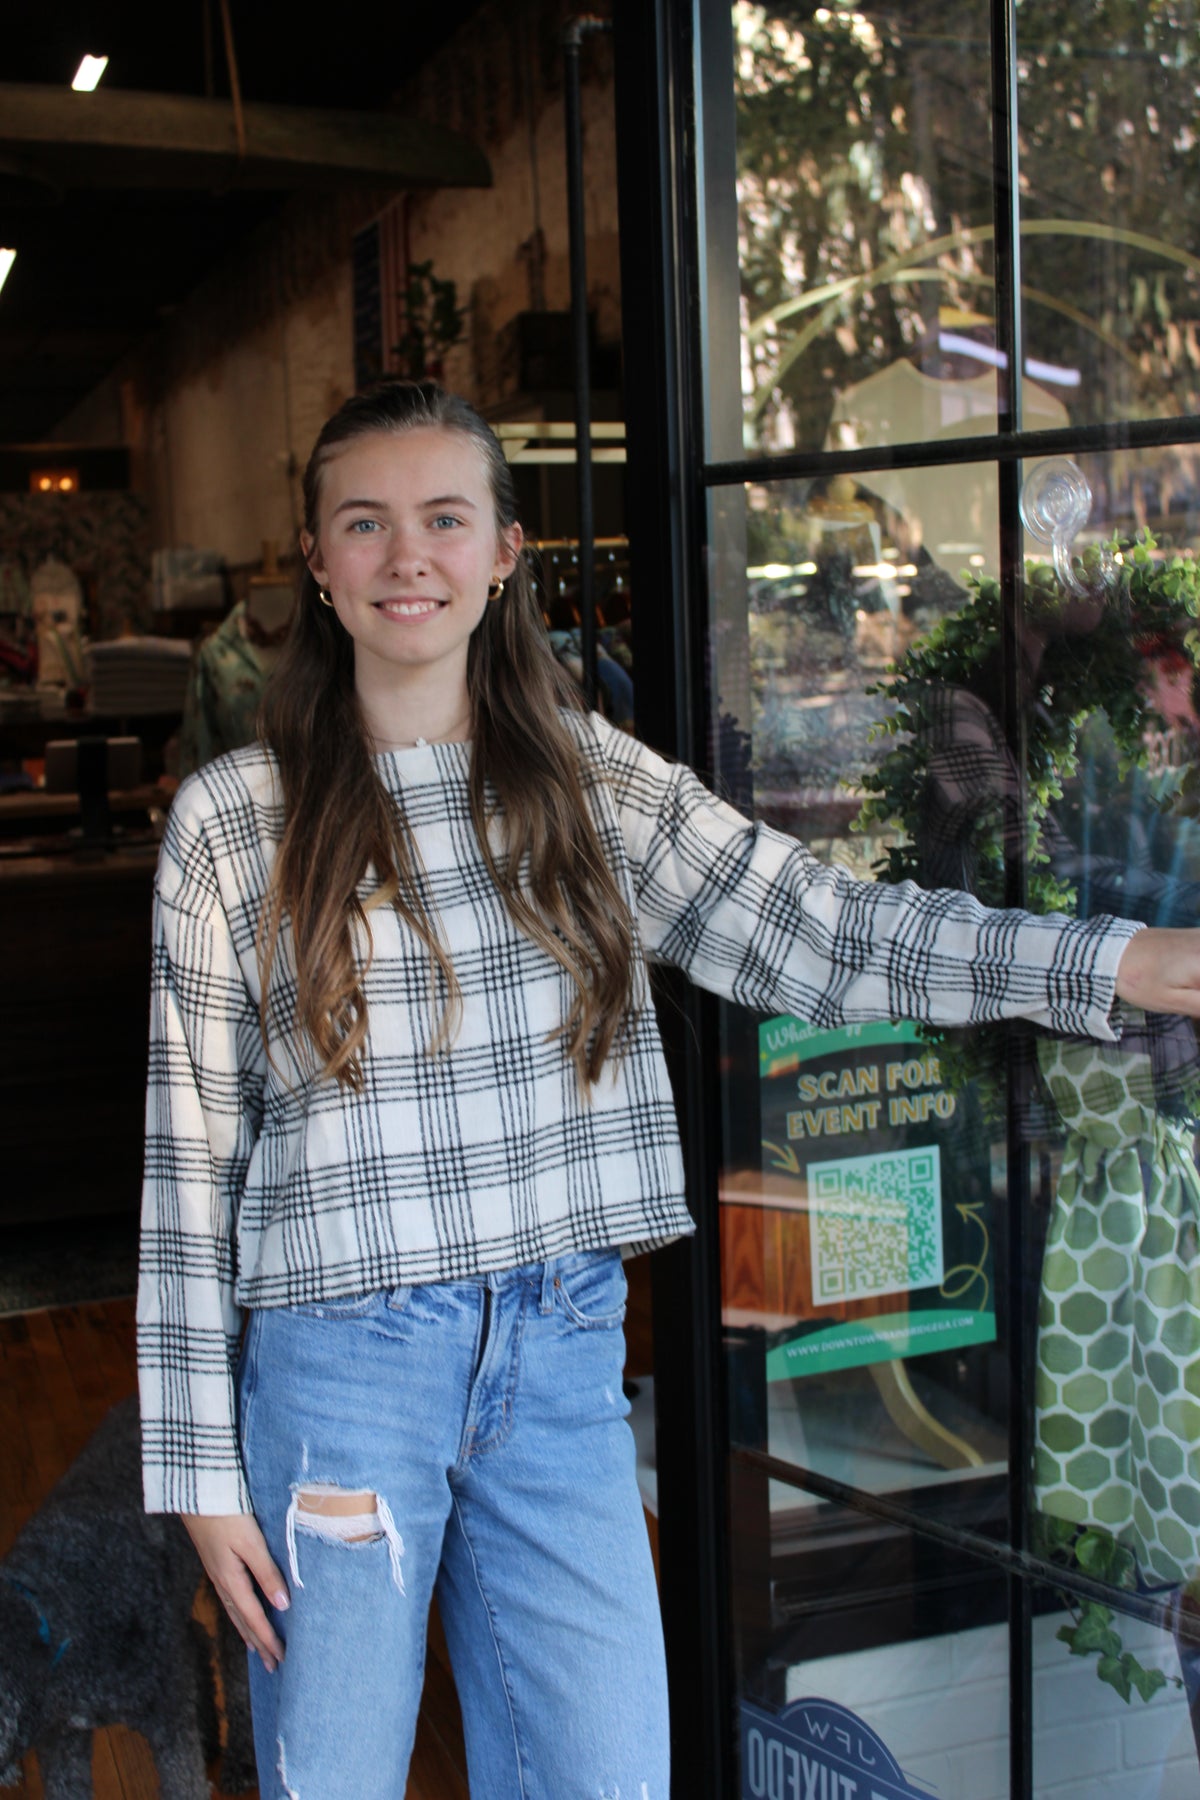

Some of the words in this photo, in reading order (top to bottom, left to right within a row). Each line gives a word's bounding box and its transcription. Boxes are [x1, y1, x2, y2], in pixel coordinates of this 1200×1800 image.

[766, 1022, 829, 1051] What
[797, 1065, 880, 1102] SCAN
[886, 1057, 942, 1091] FOR
[786, 1101, 881, 1140] EVENT
[889, 1090, 956, 1126] INFO
